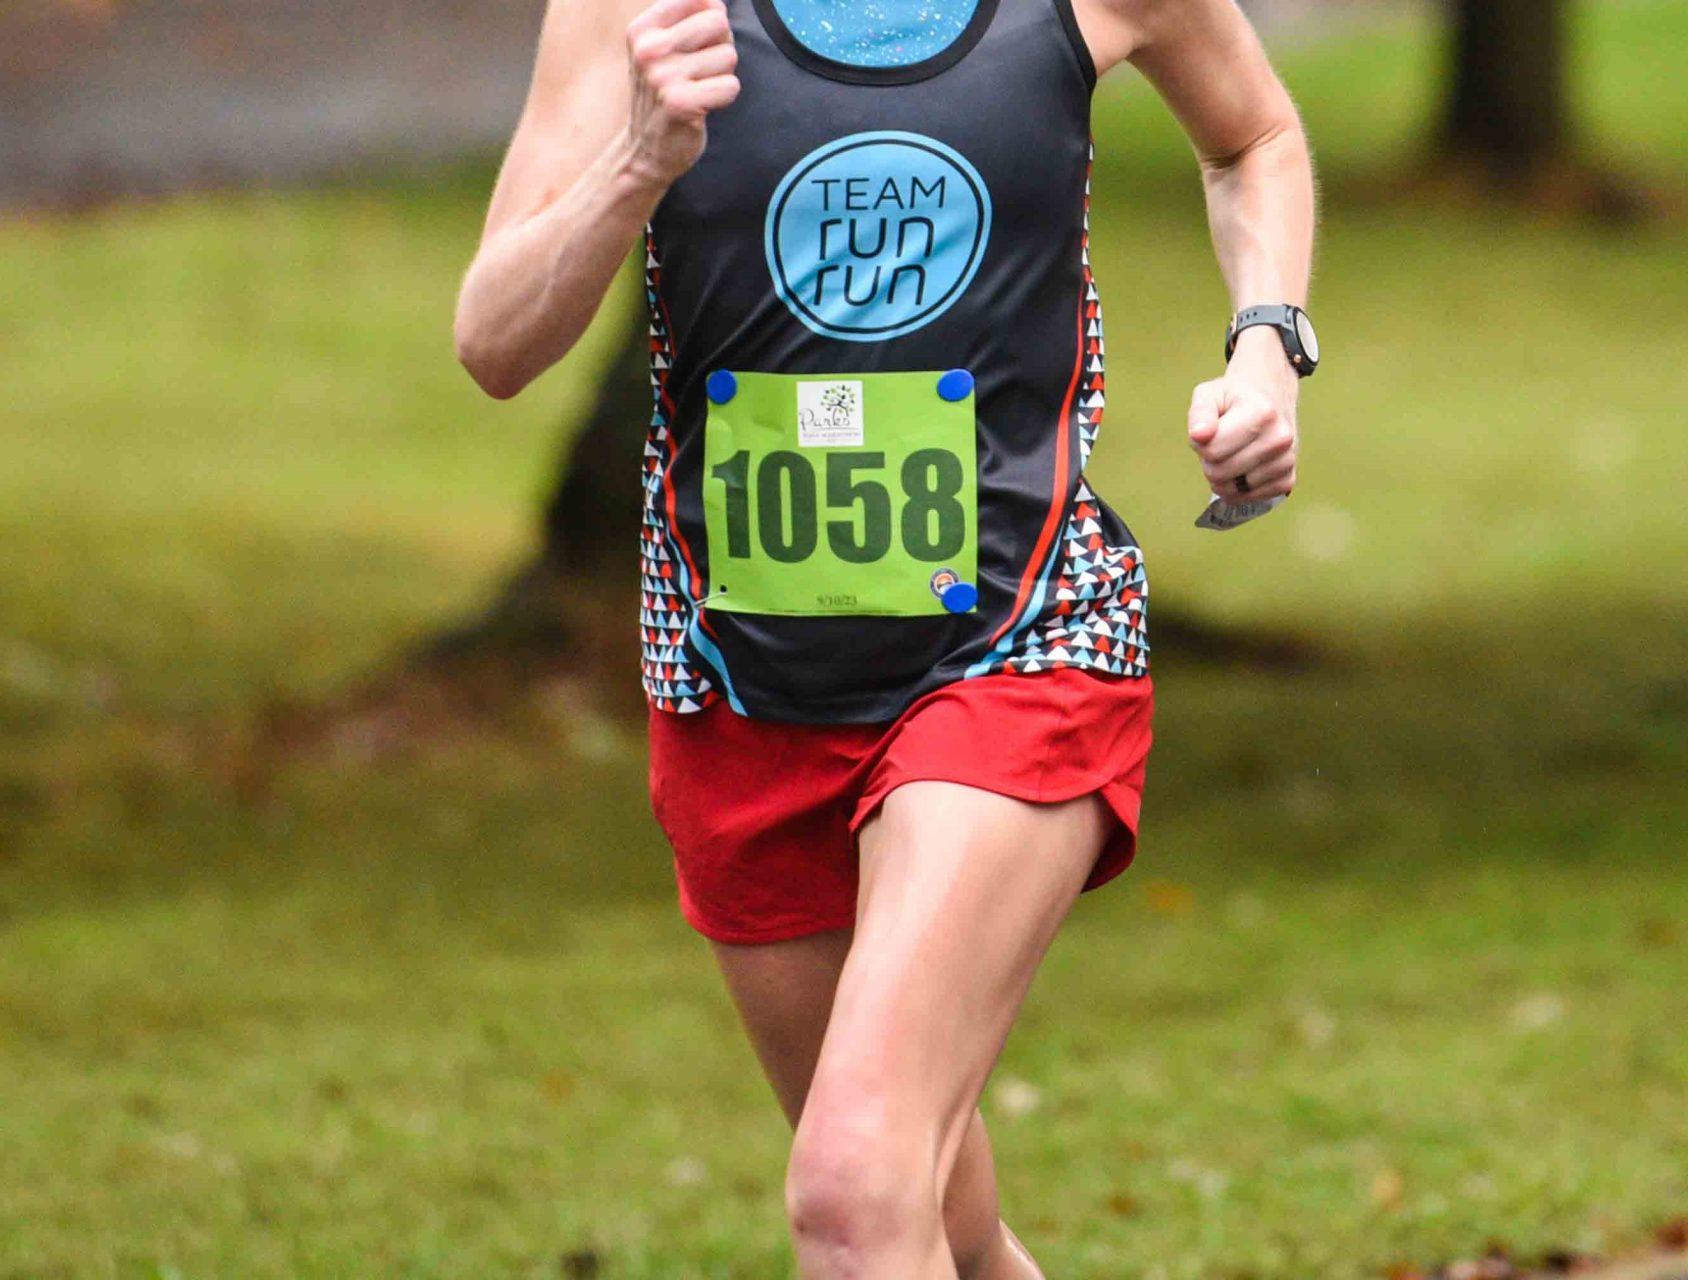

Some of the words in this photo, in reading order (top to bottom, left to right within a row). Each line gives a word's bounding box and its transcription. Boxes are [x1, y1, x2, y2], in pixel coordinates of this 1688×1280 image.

[811, 176, 946, 211] TEAM
[819, 216, 935, 261] run
[813, 264, 926, 307] run
[711, 448, 966, 564] 1058
